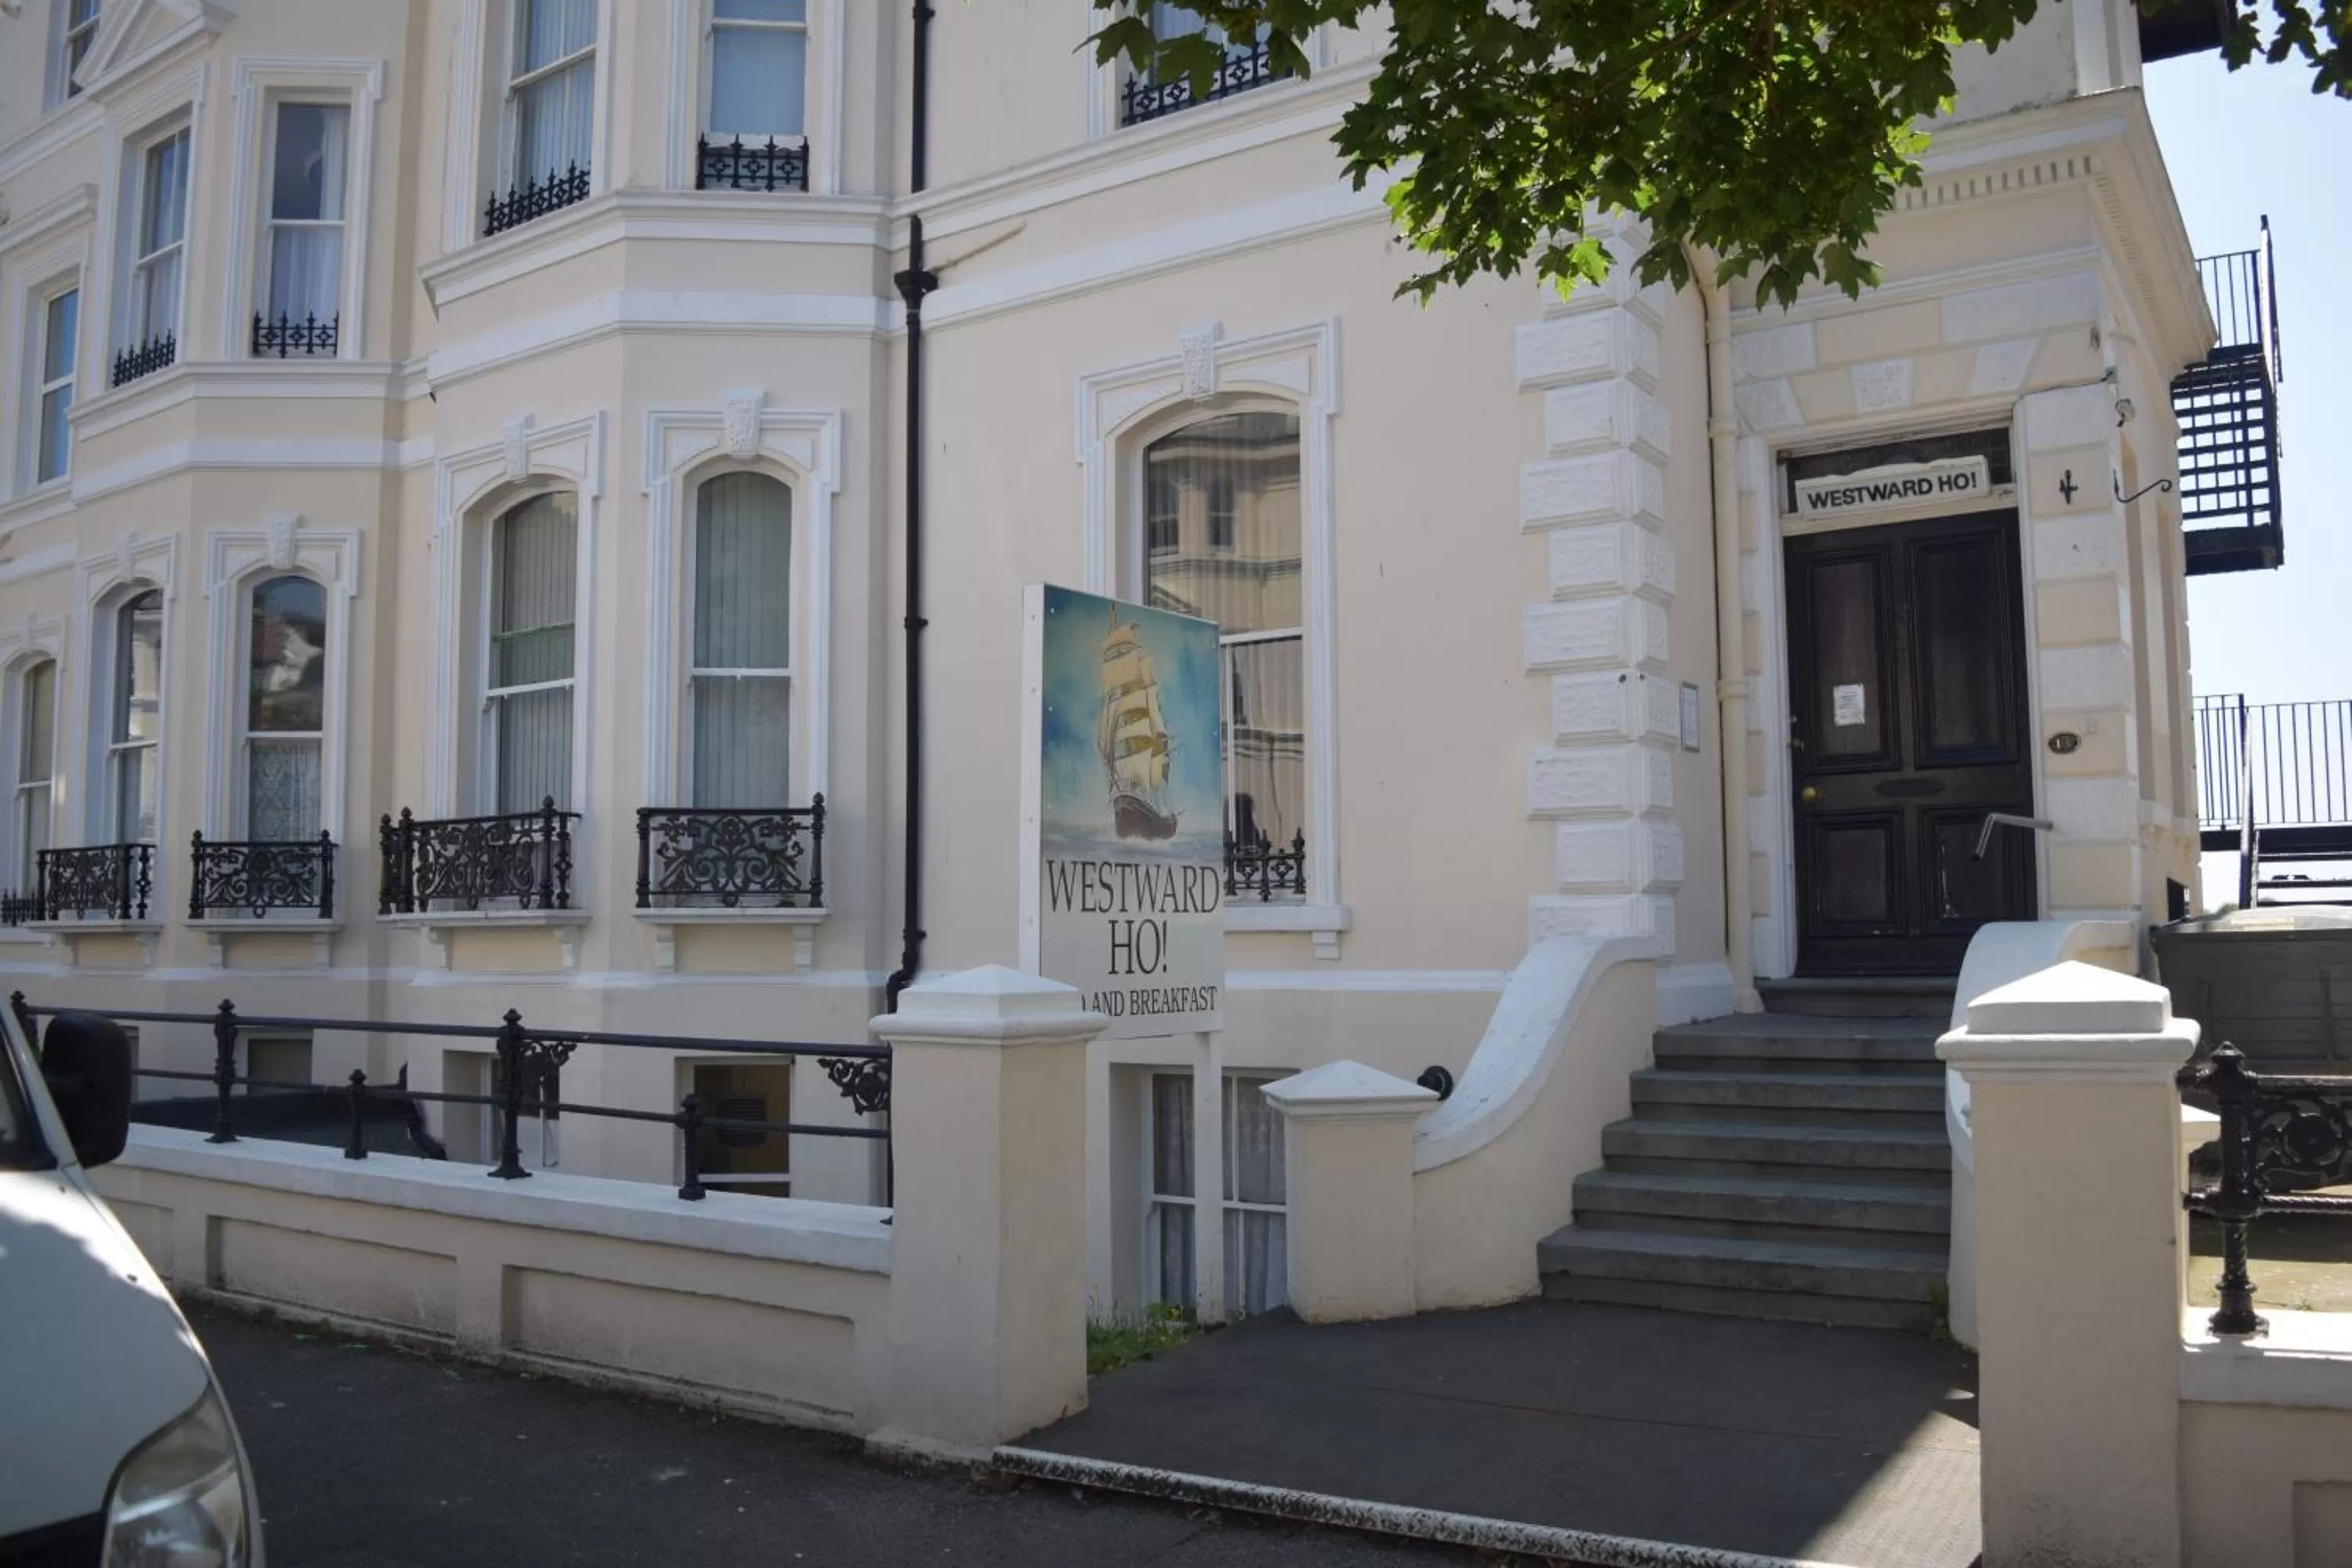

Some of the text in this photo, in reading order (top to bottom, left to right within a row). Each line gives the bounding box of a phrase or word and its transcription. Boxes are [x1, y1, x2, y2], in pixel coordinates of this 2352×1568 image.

[1807, 471, 1977, 510] WESTWARD HO!
[1046, 859, 1220, 913] WESTWARD
[1108, 919, 1168, 975] HO!
[1091, 991, 1124, 1017] AND
[1130, 985, 1218, 1015] BREAKFAST
